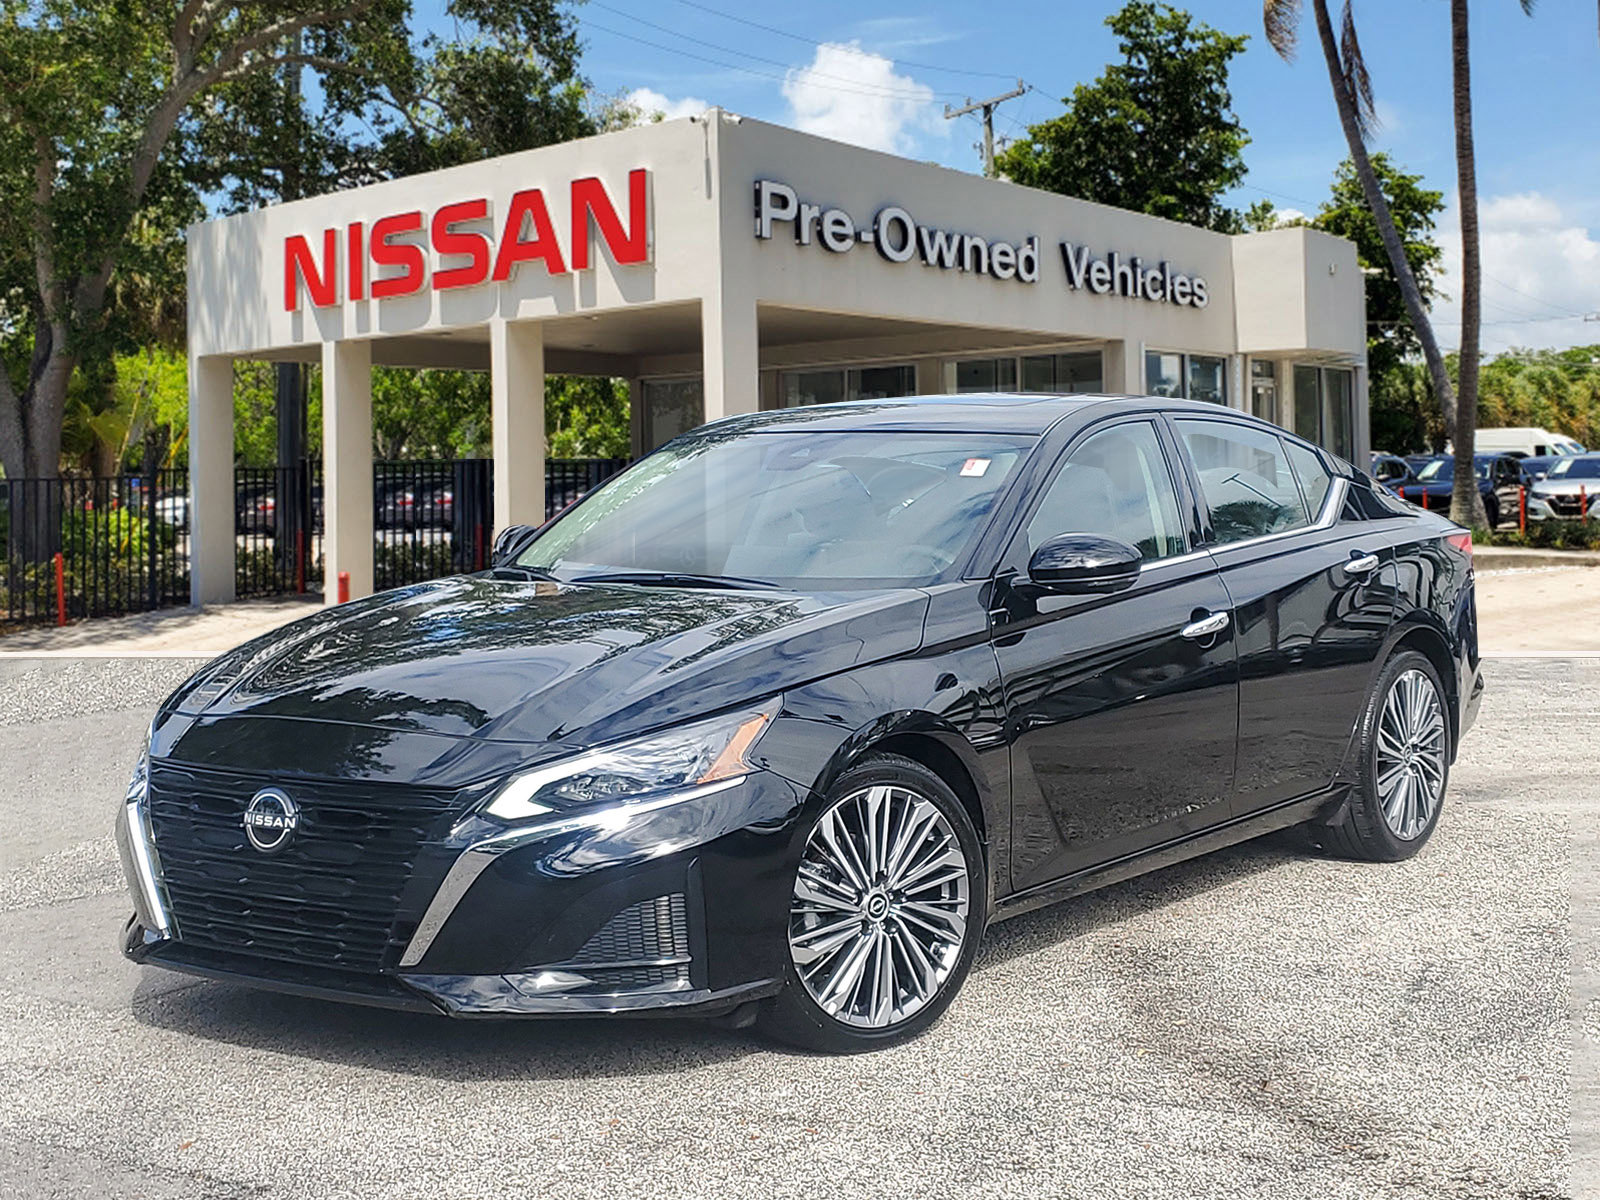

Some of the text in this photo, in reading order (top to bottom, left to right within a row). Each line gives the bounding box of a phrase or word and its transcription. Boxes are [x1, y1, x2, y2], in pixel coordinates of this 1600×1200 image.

[285, 169, 648, 311] NISSAN
[756, 180, 1209, 308] Pre-Owned Vehicles
[244, 812, 296, 828] NISSAN
